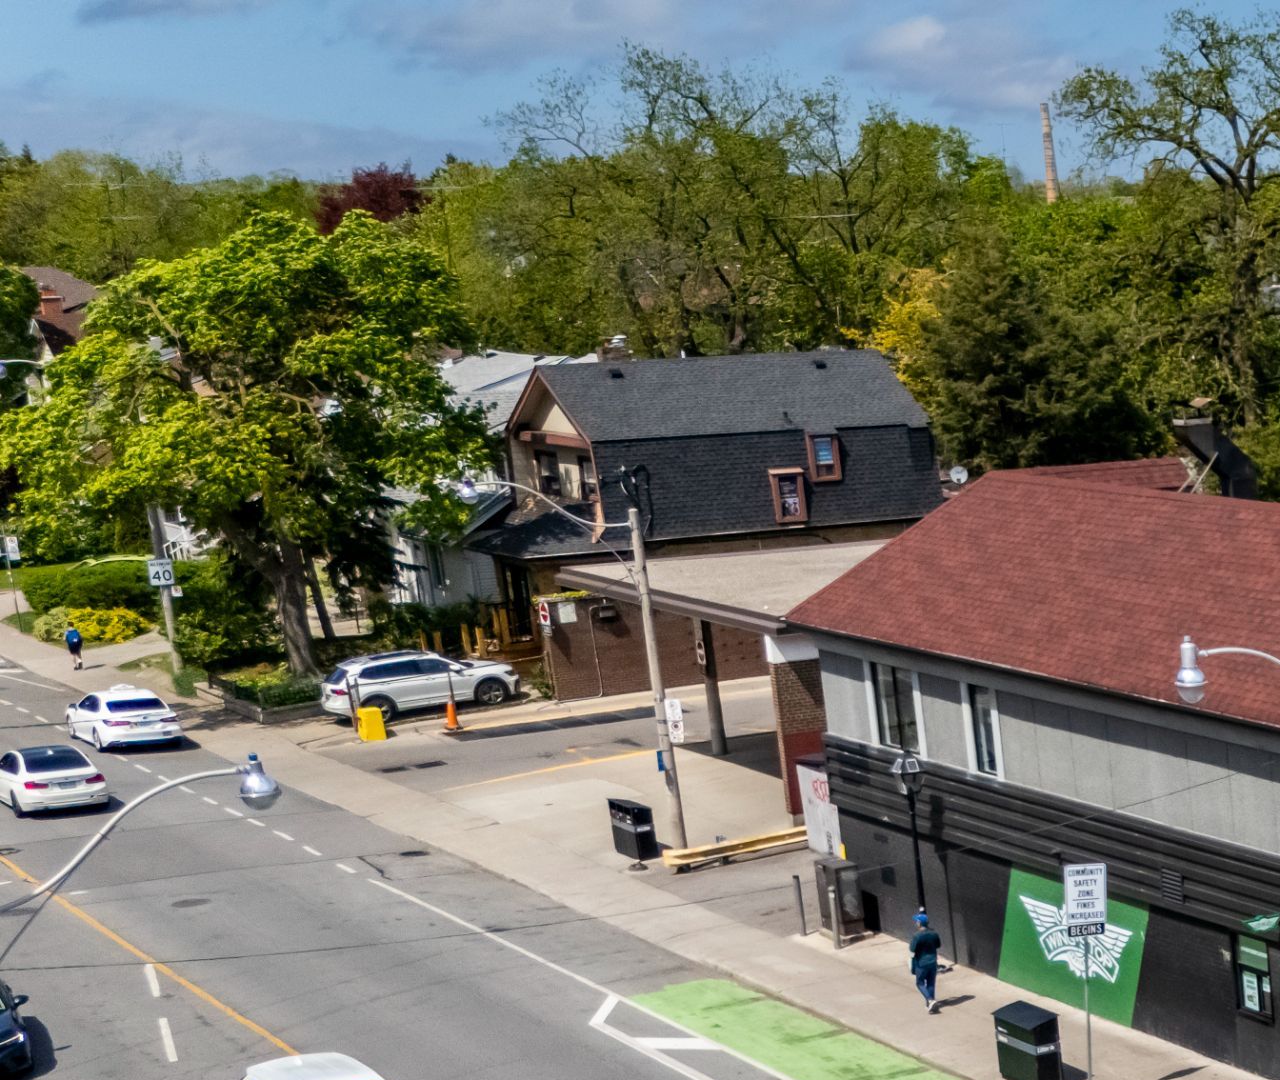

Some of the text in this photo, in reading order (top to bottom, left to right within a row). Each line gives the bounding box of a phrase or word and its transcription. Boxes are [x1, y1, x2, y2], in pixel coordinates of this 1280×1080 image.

[152, 569, 172, 582] 40
[1068, 867, 1103, 877] COMMUNITY
[1073, 879, 1097, 888] SAFETY
[1078, 889, 1094, 898] ZONE
[1077, 901, 1096, 910] FINES
[1068, 911, 1105, 920] INCREASED
[1070, 924, 1102, 936] BEGINS
